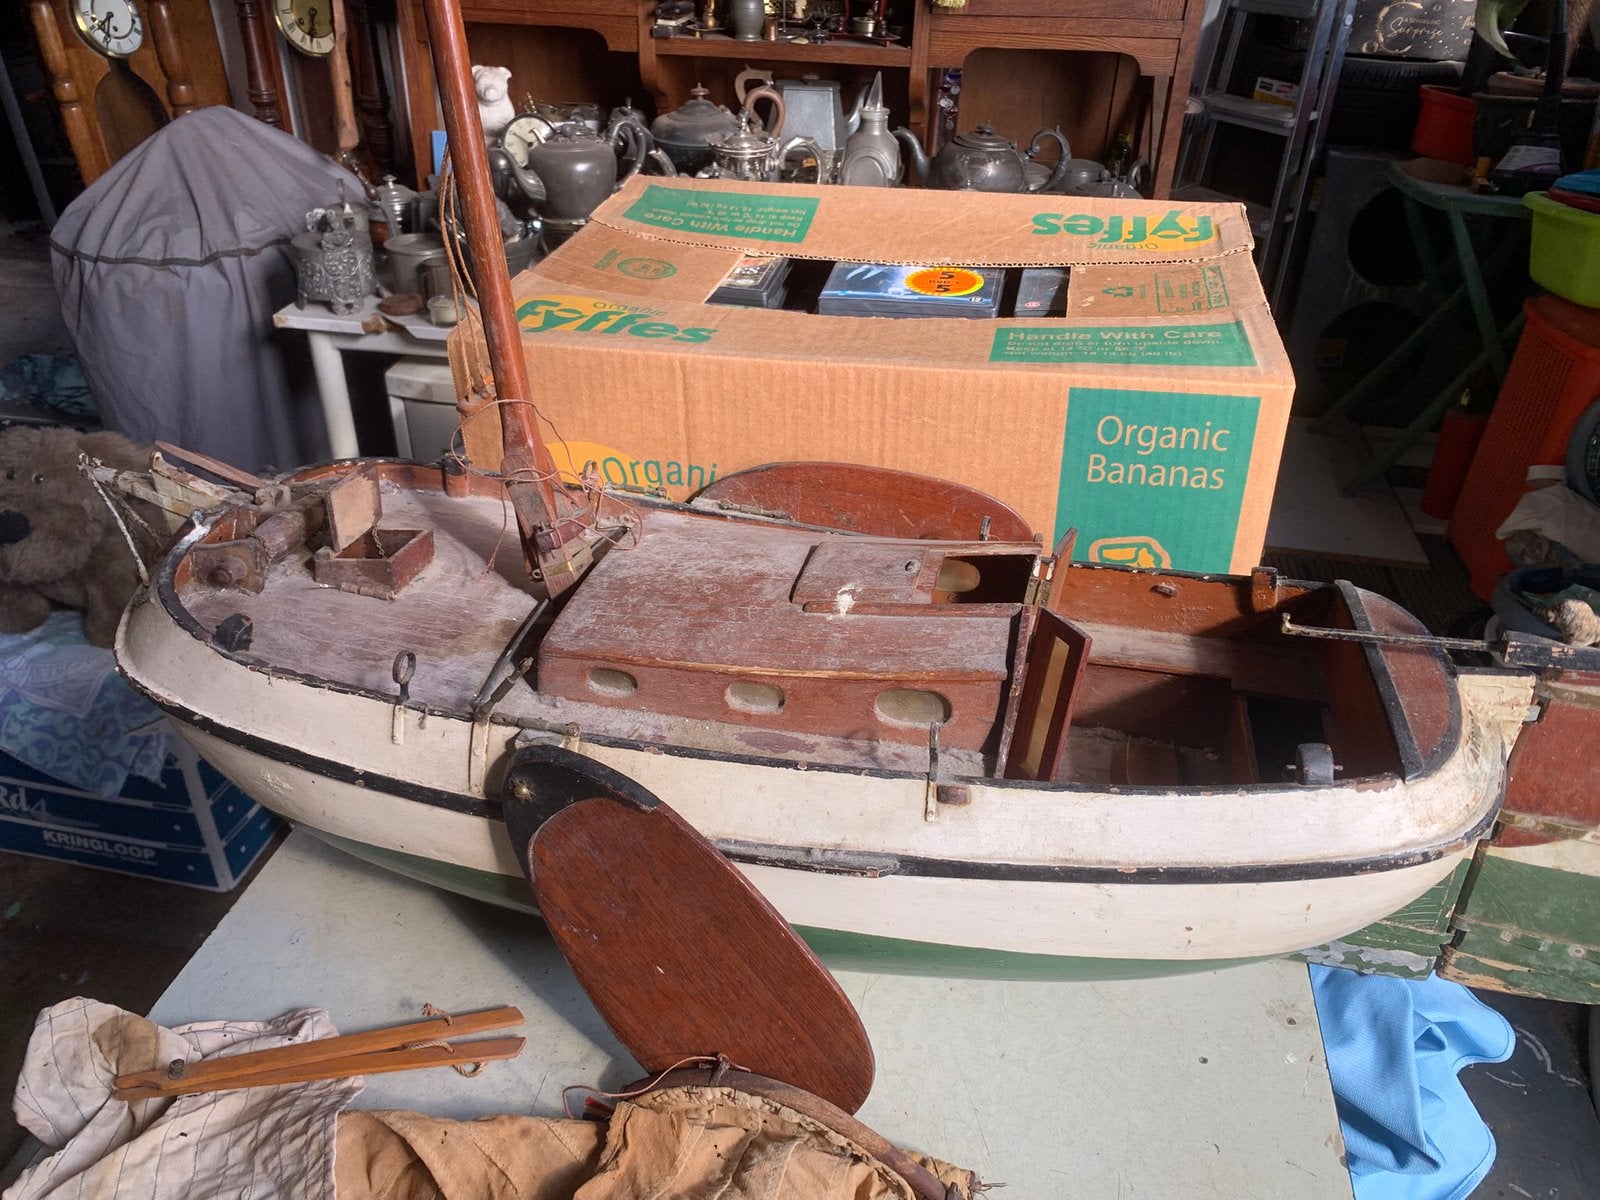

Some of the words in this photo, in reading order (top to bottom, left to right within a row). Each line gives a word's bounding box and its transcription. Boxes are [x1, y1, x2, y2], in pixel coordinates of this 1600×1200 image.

[1387, 16, 1444, 39] Surprise
[644, 212, 685, 226] Care
[690, 220, 729, 232] With
[734, 225, 797, 238] Handle
[1086, 243, 1159, 251] Organic
[939, 271, 956, 280] 5
[934, 284, 951, 293] 5
[593, 300, 669, 317] Organic
[1008, 332, 1092, 341] Handle
[1099, 331, 1155, 340] With
[1163, 330, 1222, 339] Care
[1097, 415, 1231, 455] Organic
[602, 457, 718, 500] Organi
[1087, 454, 1226, 490] Bananas
[43, 829, 156, 859] KRINGLOOP
